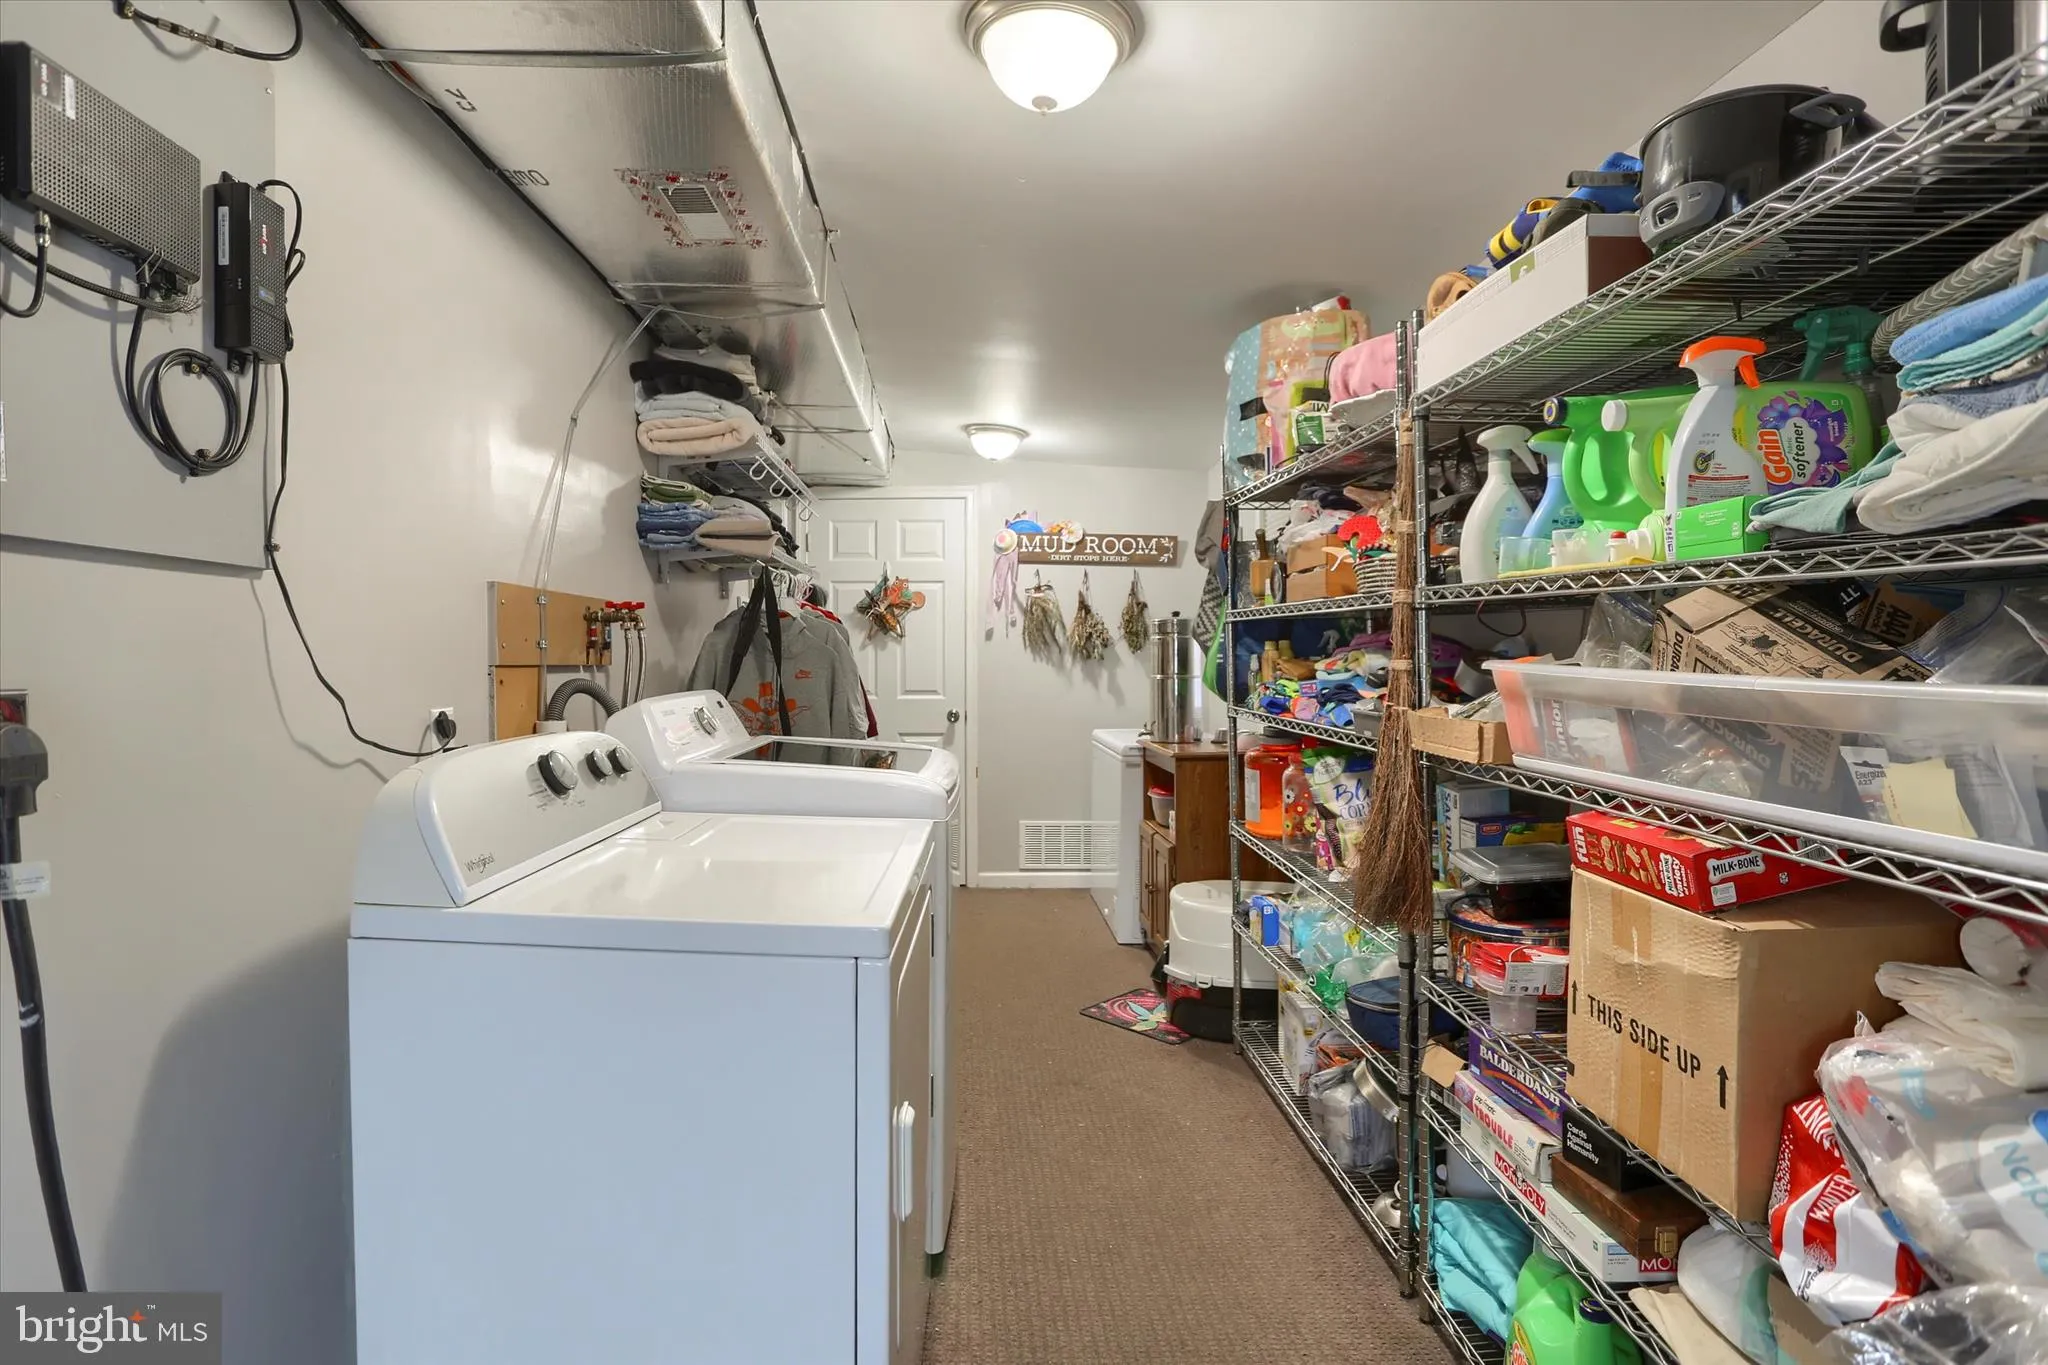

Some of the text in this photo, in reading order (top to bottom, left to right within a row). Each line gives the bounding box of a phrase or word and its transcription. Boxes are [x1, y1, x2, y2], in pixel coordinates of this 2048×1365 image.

[1757, 430, 1792, 484] Gain
[1793, 423, 1810, 479] softener
[1020, 535, 1158, 555] MUD ROOM
[1670, 631, 1684, 672] DURA
[1772, 608, 1863, 664] DURACELL
[1700, 716, 1771, 769] DURACE
[464, 853, 496, 874] Whirlpool
[1572, 826, 1589, 863] fun
[1672, 857, 1685, 897] variety
[1588, 994, 1701, 1079] THIS SIDE UP
[1480, 1044, 1560, 1107] BALDERDASH
[1474, 1103, 1514, 1150] TROUBLE
[1567, 1122, 1587, 1140] Cards
[1567, 1131, 1592, 1152] Against
[1567, 1139, 1599, 1164] Humanity
[1495, 1154, 1545, 1212] MONOPOLY
[1809, 1174, 1859, 1223] WINTER
